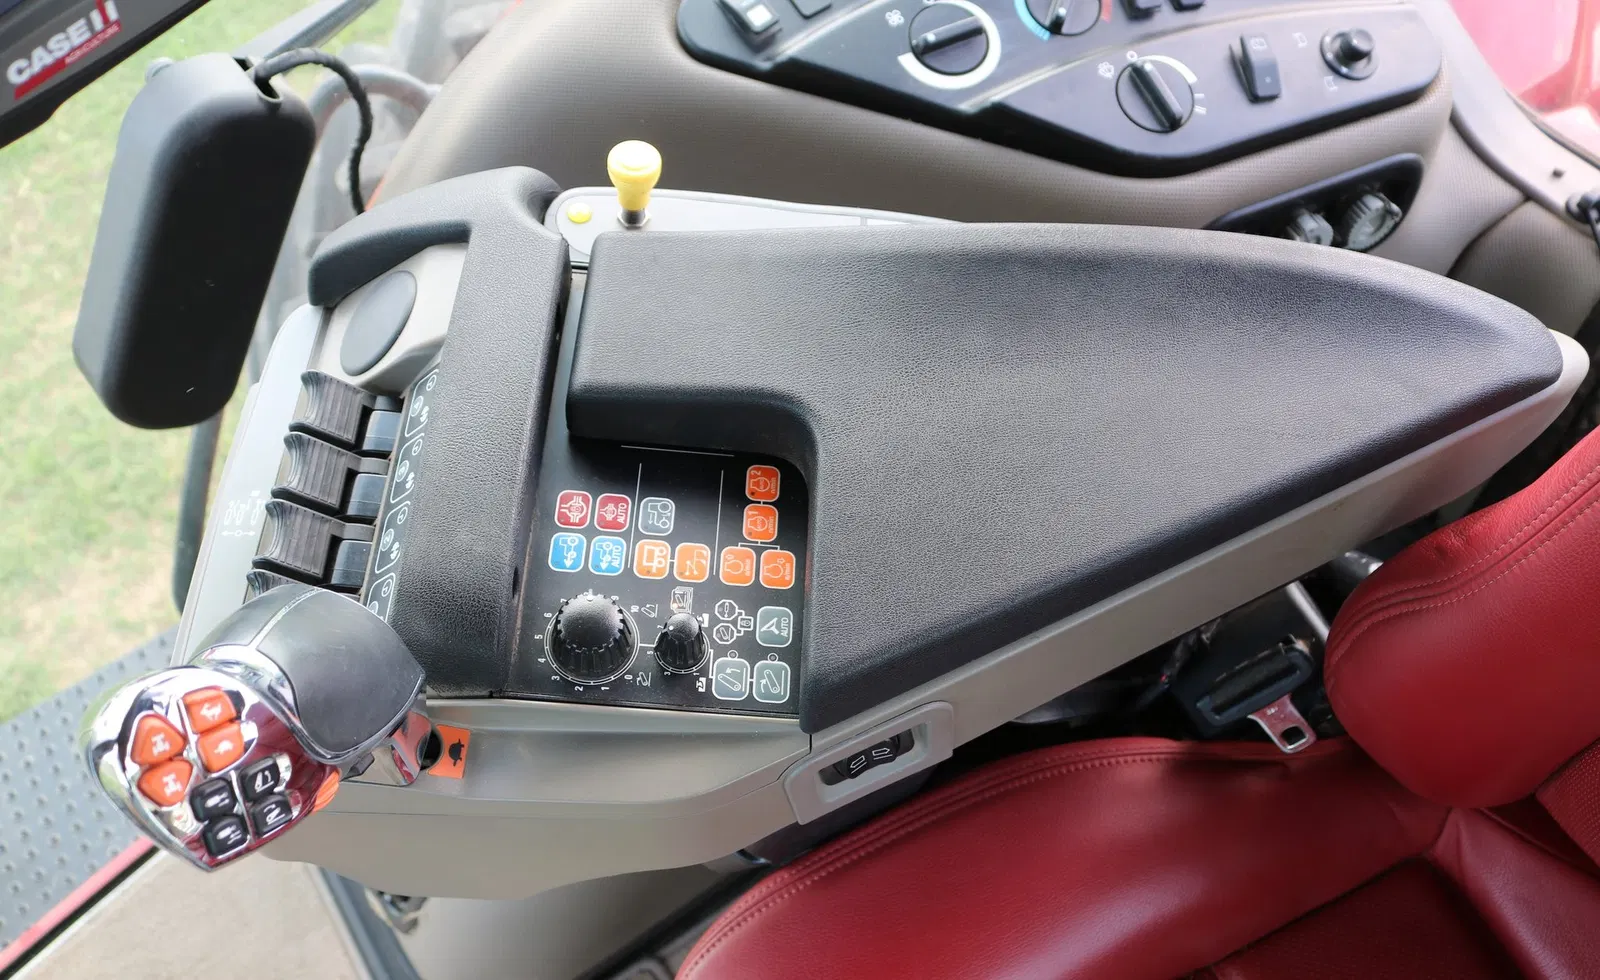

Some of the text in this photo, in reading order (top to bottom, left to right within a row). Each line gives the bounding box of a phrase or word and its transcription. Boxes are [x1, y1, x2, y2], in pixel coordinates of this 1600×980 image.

[7, 18, 92, 84] CASE
[616, 502, 628, 524] AUTO
[611, 545, 622, 568] AUTO
[630, 605, 640, 613] 10
[780, 617, 789, 638] AUTO
